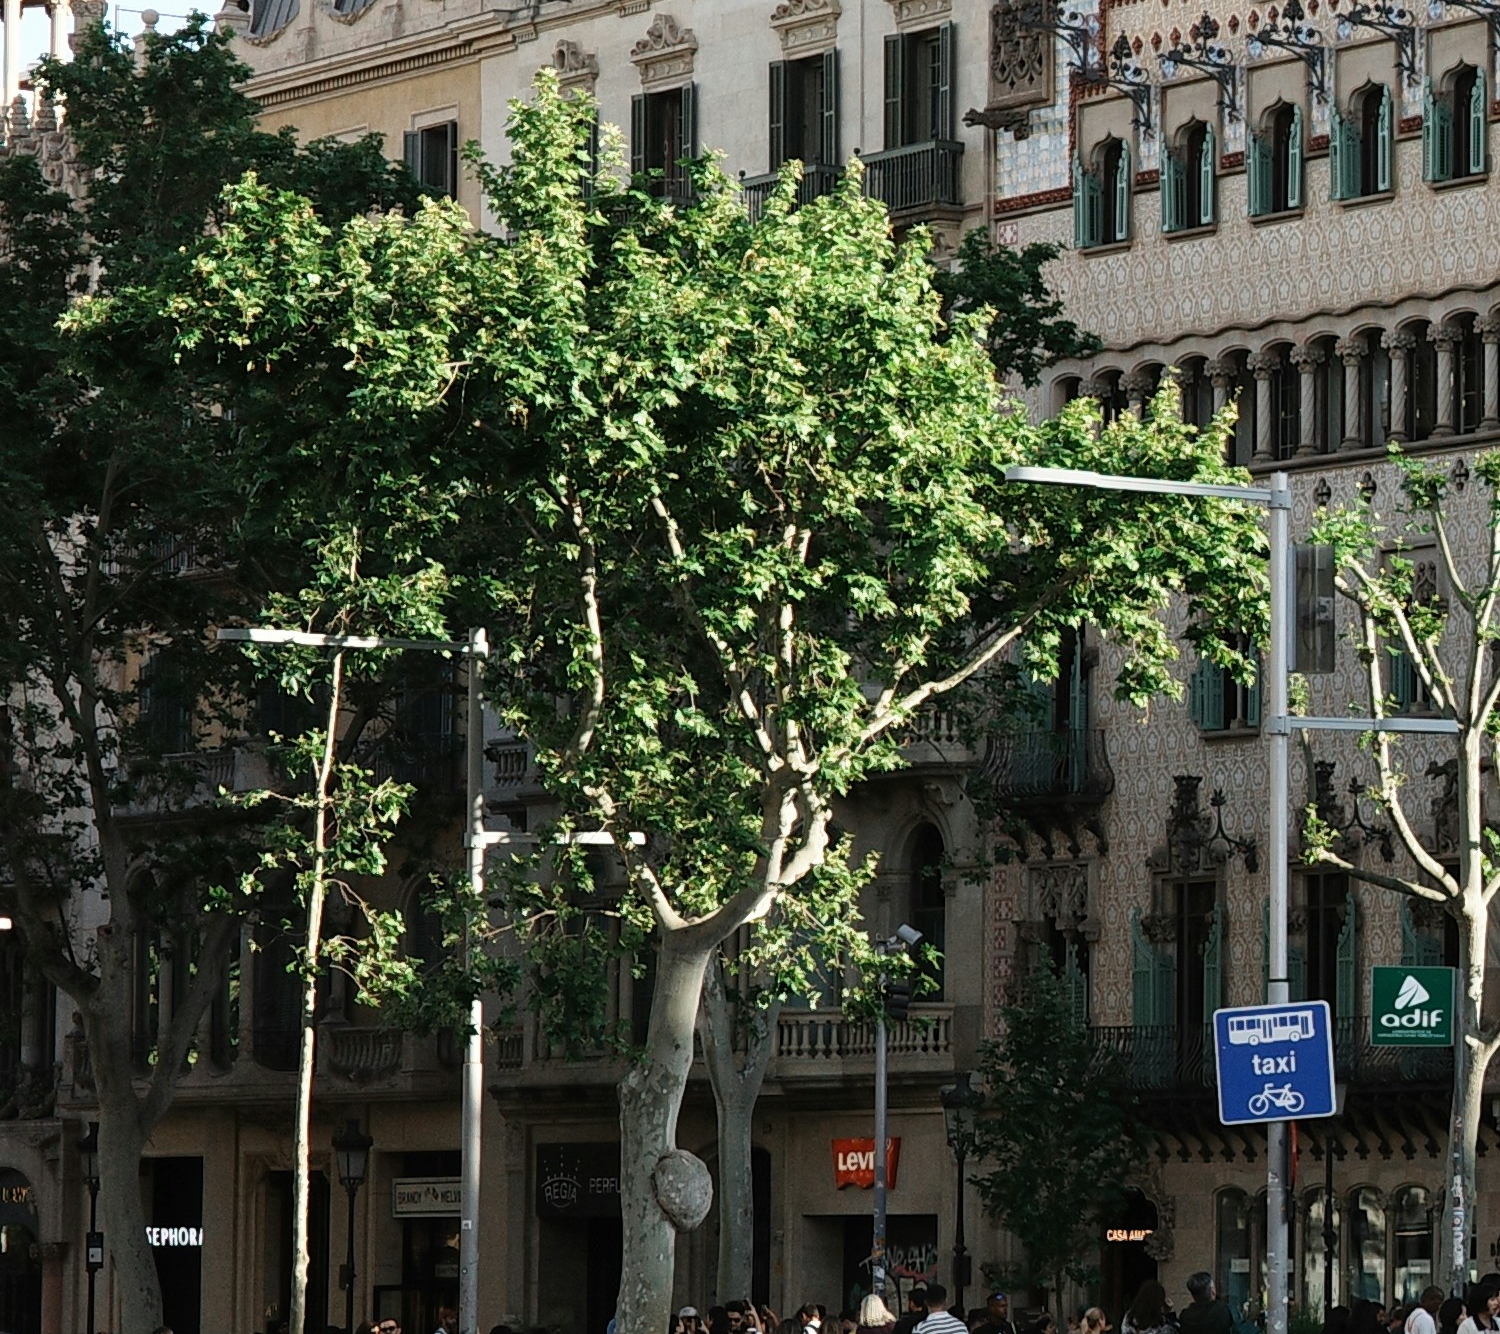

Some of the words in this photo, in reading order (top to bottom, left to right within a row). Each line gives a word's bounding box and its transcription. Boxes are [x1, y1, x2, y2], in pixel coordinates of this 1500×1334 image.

[1380, 1008, 1444, 1028] adif
[1251, 1050, 1296, 1075] taxi
[545, 1182, 577, 1203] REGIA
[1107, 1229, 1128, 1242] CASA
